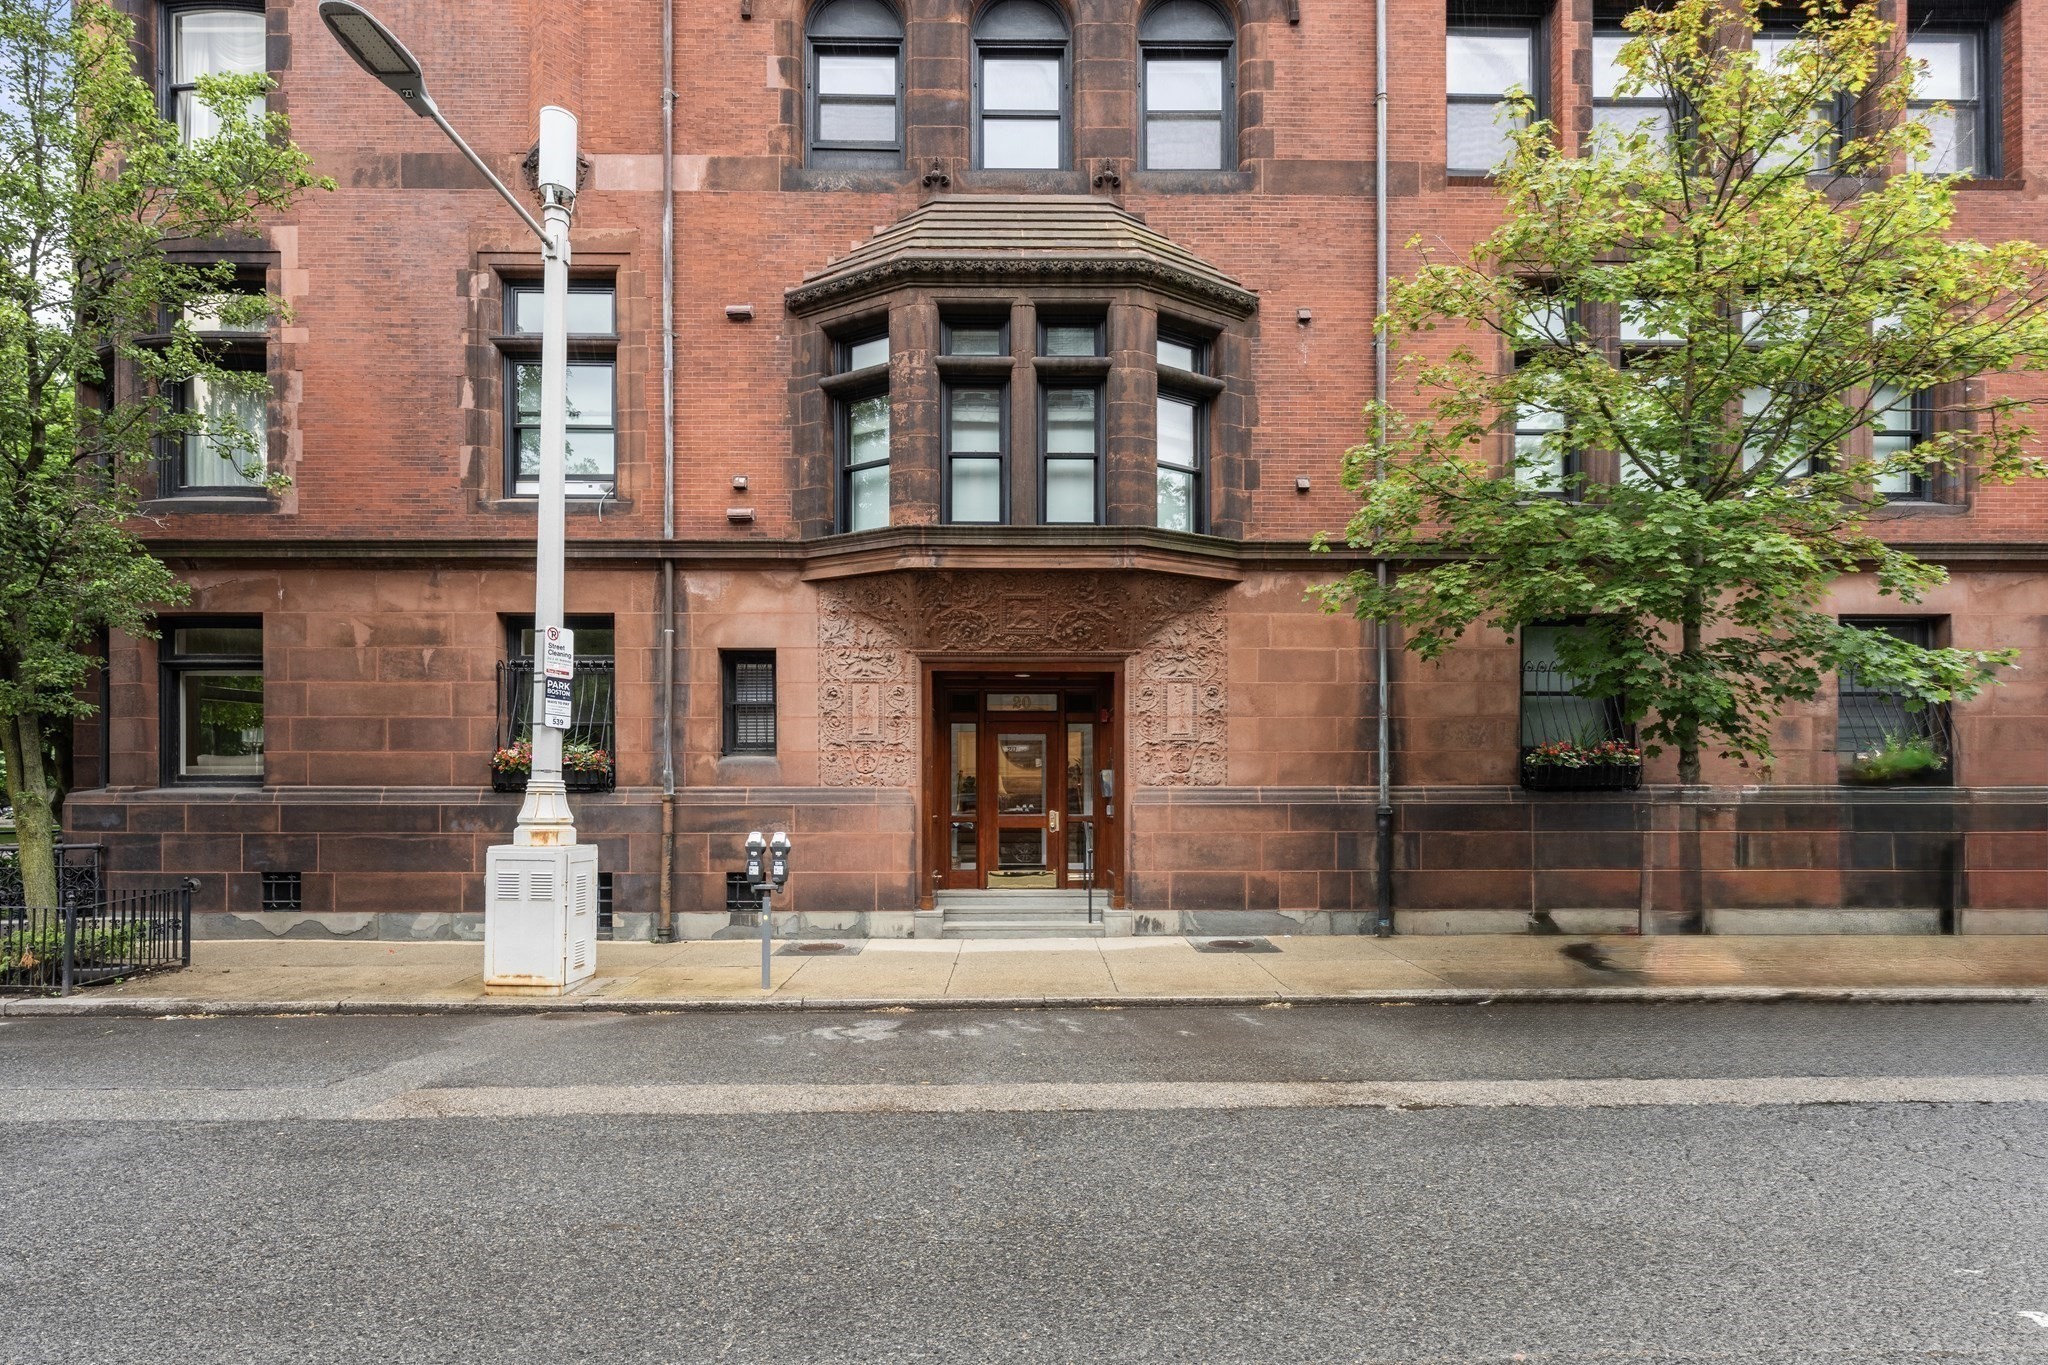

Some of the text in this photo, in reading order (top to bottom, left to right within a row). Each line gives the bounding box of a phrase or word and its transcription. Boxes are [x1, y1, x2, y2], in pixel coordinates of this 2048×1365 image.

[402, 89, 414, 98] 27
[548, 642, 565, 651] Street
[547, 649, 572, 660] Cleaning
[547, 679, 570, 691] PARK
[547, 688, 570, 696] BOSTON
[1012, 695, 1032, 709] 20
[552, 718, 564, 726] 539
